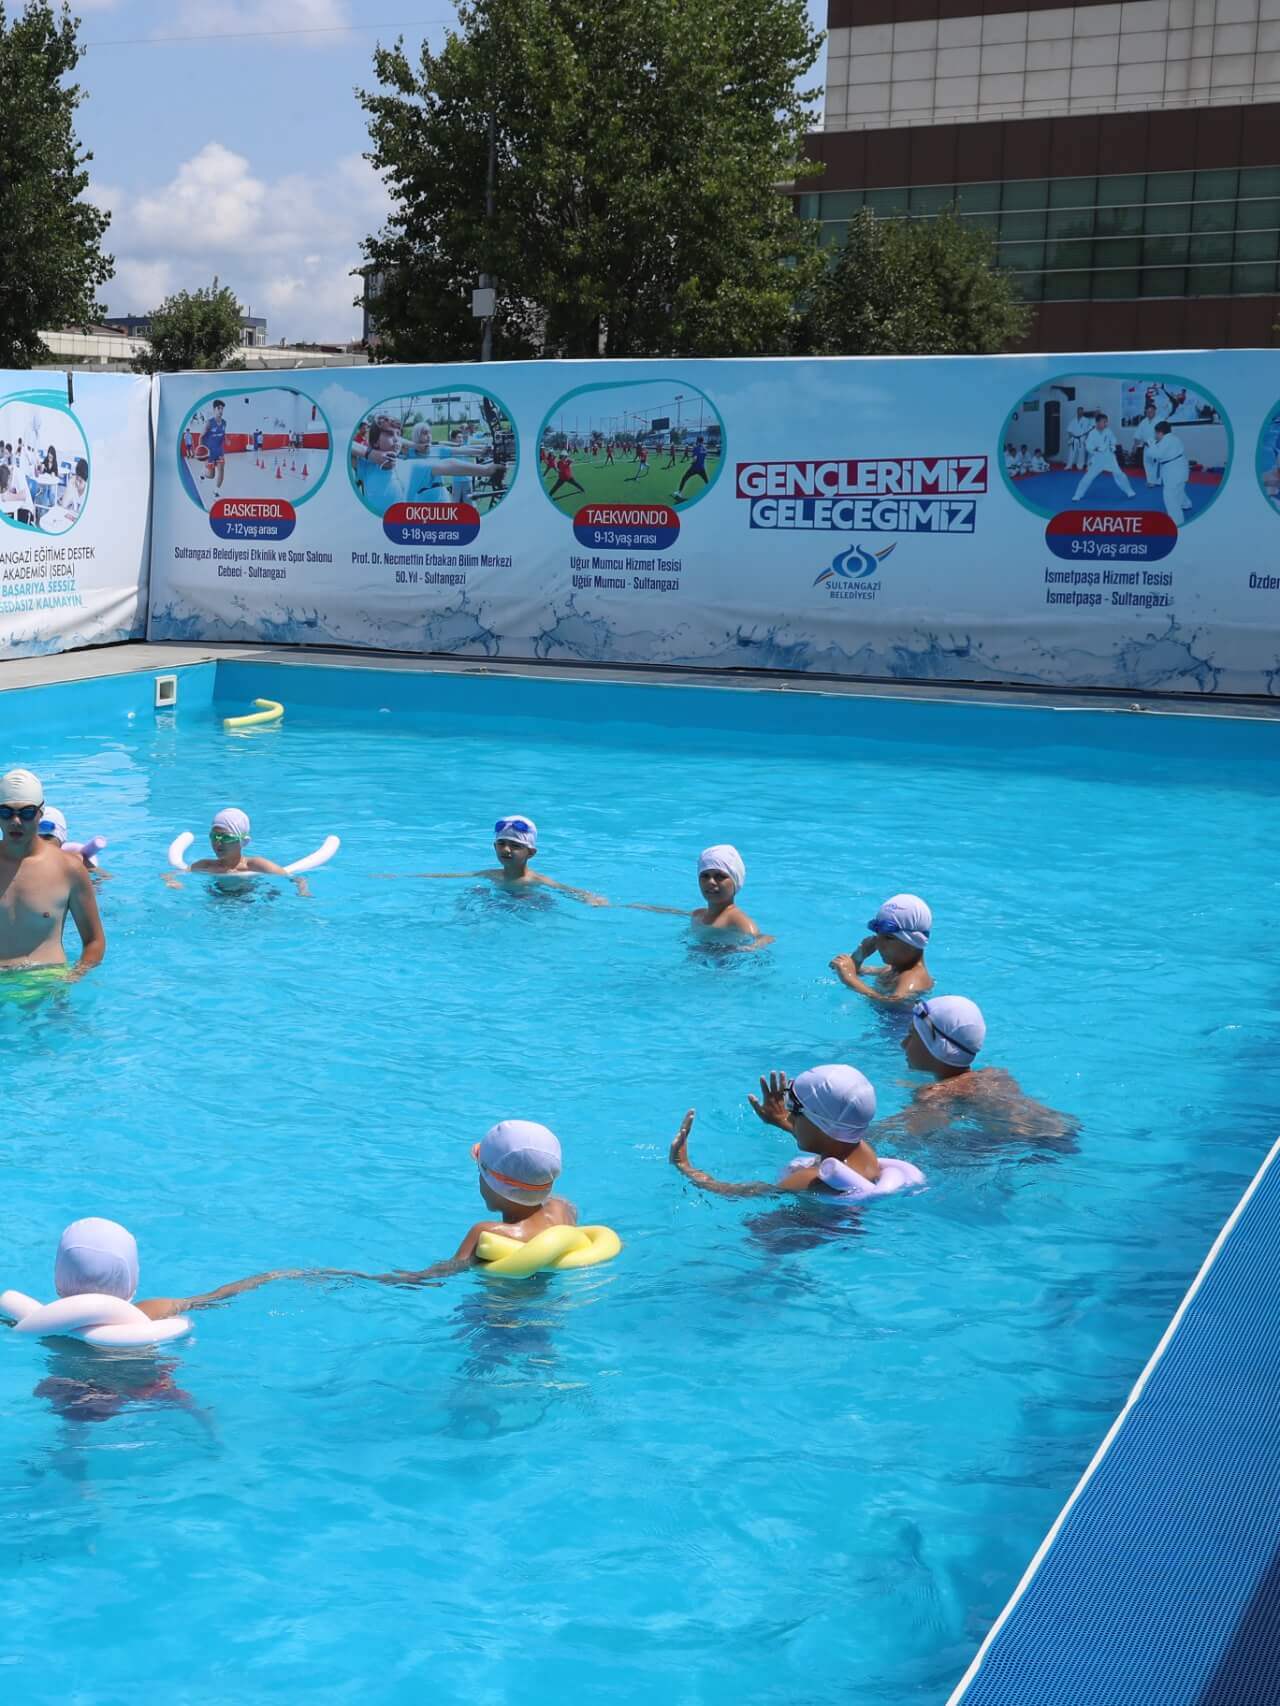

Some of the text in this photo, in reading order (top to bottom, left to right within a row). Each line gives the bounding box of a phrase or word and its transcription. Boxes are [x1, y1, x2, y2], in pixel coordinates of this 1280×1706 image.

[738, 458, 986, 497] GENÇLERİMİZ
[223, 503, 284, 518] BASKETBOL
[405, 506, 459, 523] OKÇULUK
[586, 510, 668, 525] TAEKWONDO
[751, 495, 974, 532] GELECEĞİMİZ
[243, 526, 257, 537] yaş
[258, 527, 278, 536] arası
[1082, 516, 1143, 533] KARATE
[421, 530, 437, 543] yaş
[438, 531, 460, 541] arası
[615, 534, 632, 547] yaş
[633, 535, 657, 545] arası
[34, 547, 66, 562] EĞİTİME
[67, 546, 96, 561] DESTEK
[174, 547, 333, 564] Sultangazi Belediyesi Etkinlik ve Spor Salonu
[1095, 544, 1117, 557] yaş
[1119, 544, 1148, 555] arası
[351, 552, 512, 568] Prof. Dr. Necmettin Erbakan Bilim Merkezi
[570, 556, 682, 572] Uğur Mumcu Hizmet Tesisi
[2, 563, 75, 581] AKADEMİSİ (SEDA)
[218, 565, 242, 578] Cebeci
[248, 567, 287, 581] Sultangazi
[424, 572, 466, 587] Sultangazi
[1044, 567, 1173, 587] İsmetpaşa Hizmet Tesisi
[594, 575, 626, 589] Mumcu
[633, 576, 680, 592] Sultangazi
[825, 580, 881, 591] SULTANGAZİ
[830, 590, 876, 601] BELEDİYESİ
[1046, 587, 1102, 607] İsmetpaşa
[1111, 591, 1169, 609] Sultangazi
